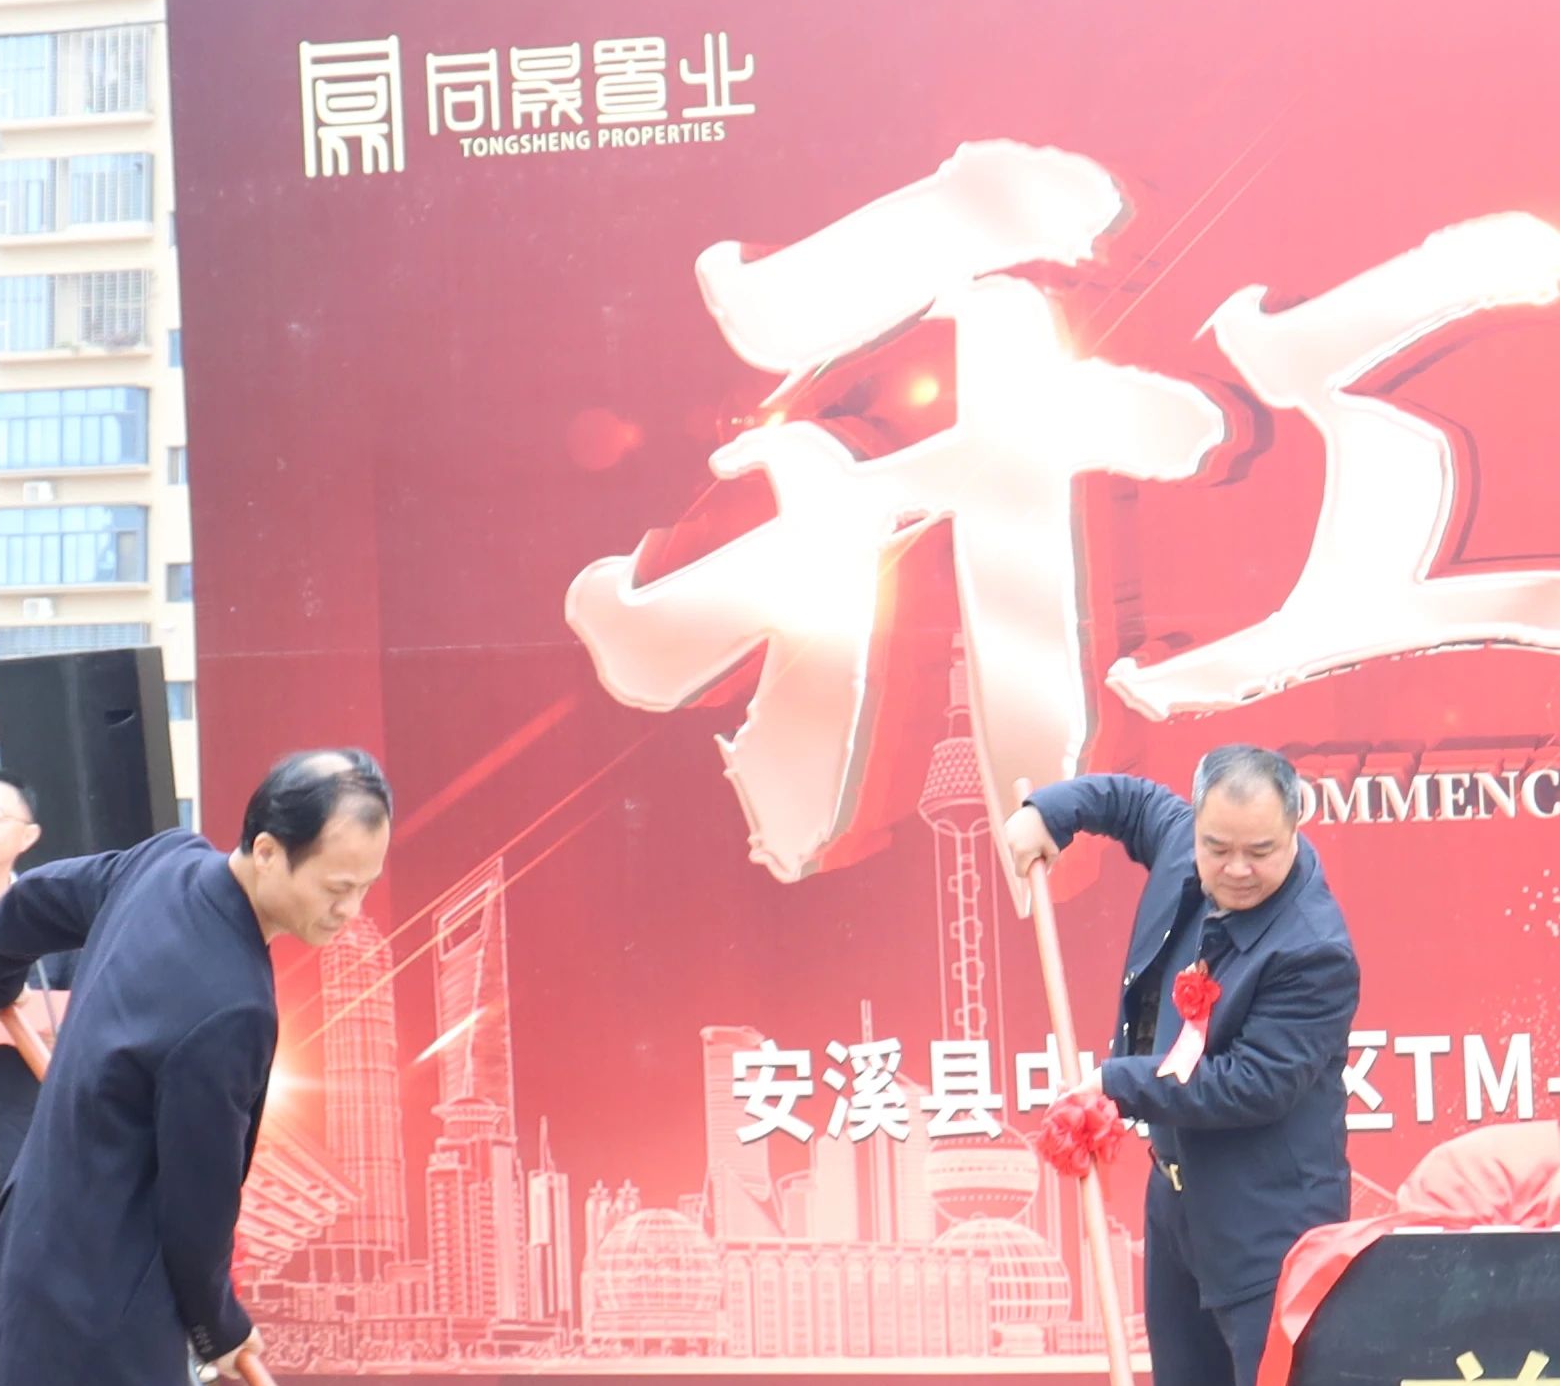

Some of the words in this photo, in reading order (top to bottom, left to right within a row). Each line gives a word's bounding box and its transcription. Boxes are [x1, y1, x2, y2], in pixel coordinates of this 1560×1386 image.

[426, 31, 756, 136] 同晟置业
[459, 130, 590, 158] TONGSHENG
[597, 121, 726, 148] PROPERTIES
